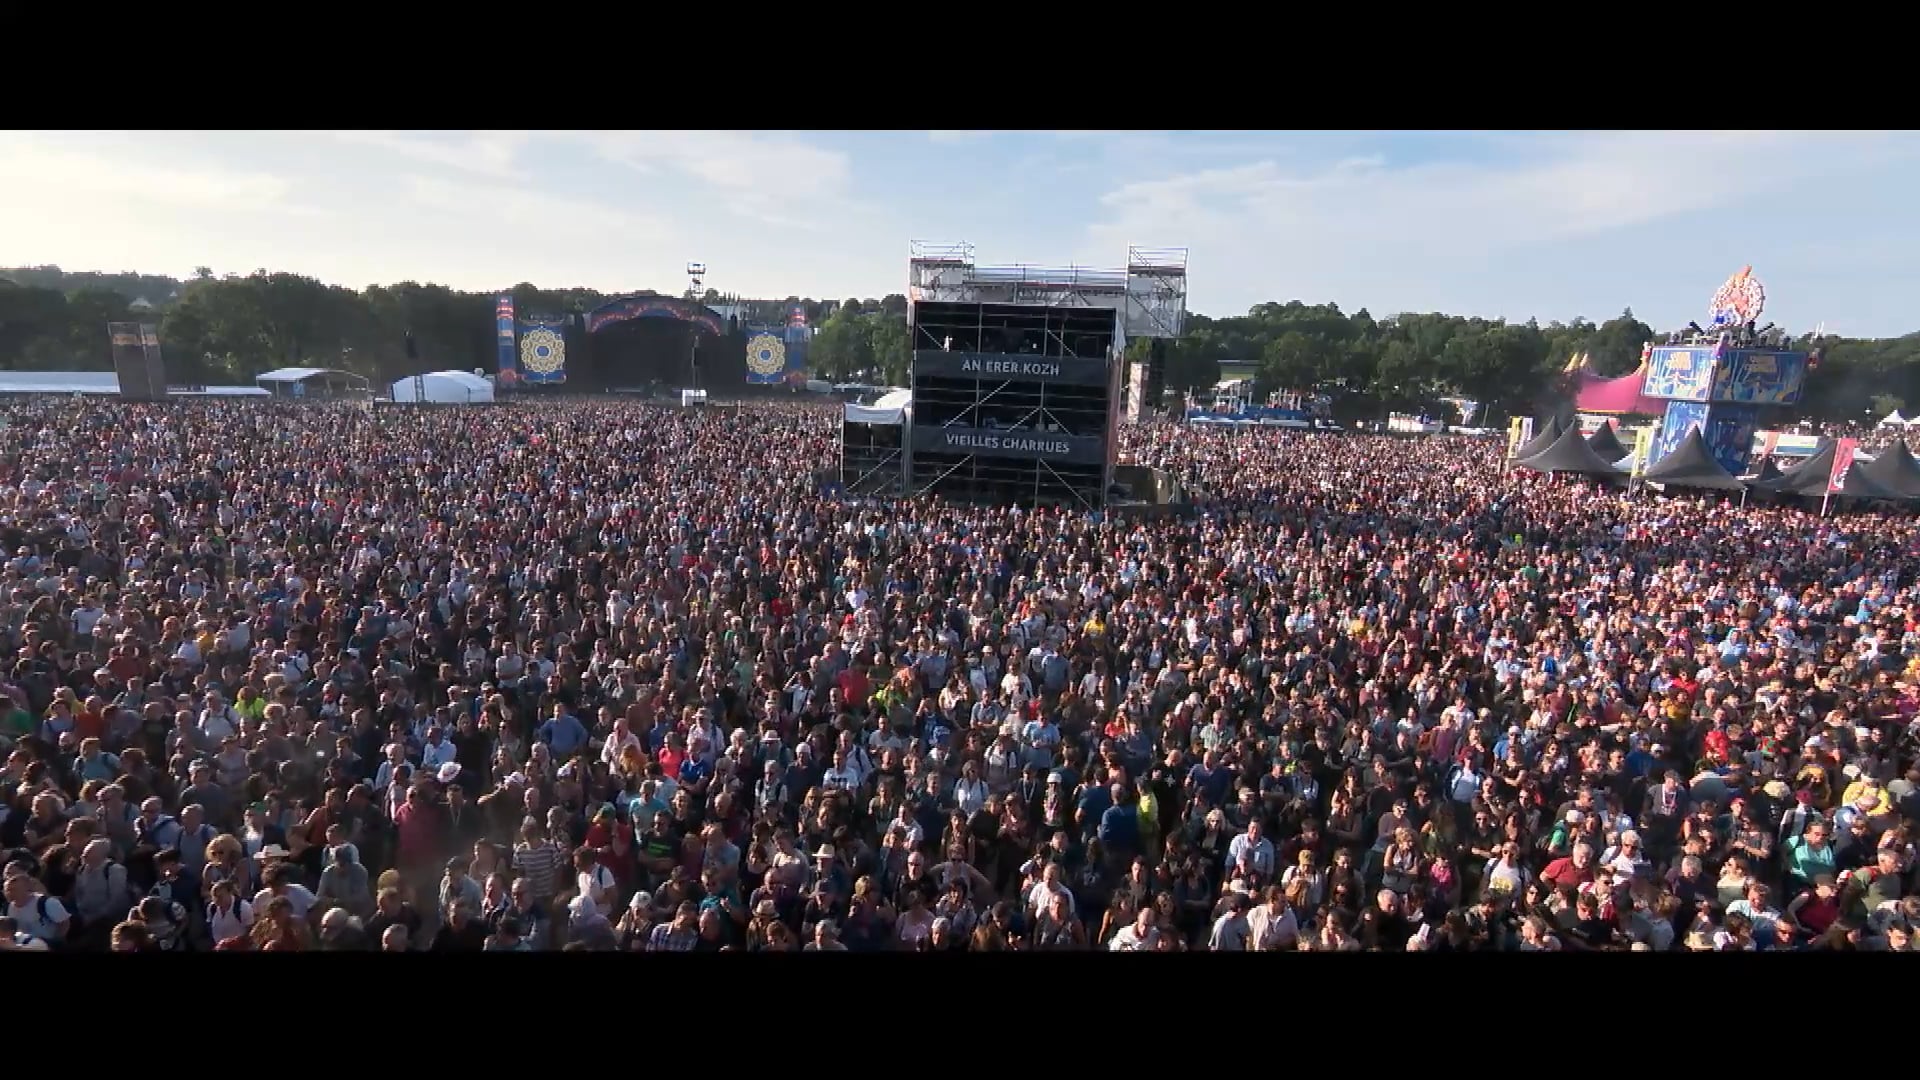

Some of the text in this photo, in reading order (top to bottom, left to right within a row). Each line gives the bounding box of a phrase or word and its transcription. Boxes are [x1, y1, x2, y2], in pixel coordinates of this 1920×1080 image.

[961, 359, 1060, 376] AN ERER KOZH
[945, 433, 1070, 454] VIEILLES CHARRUES
